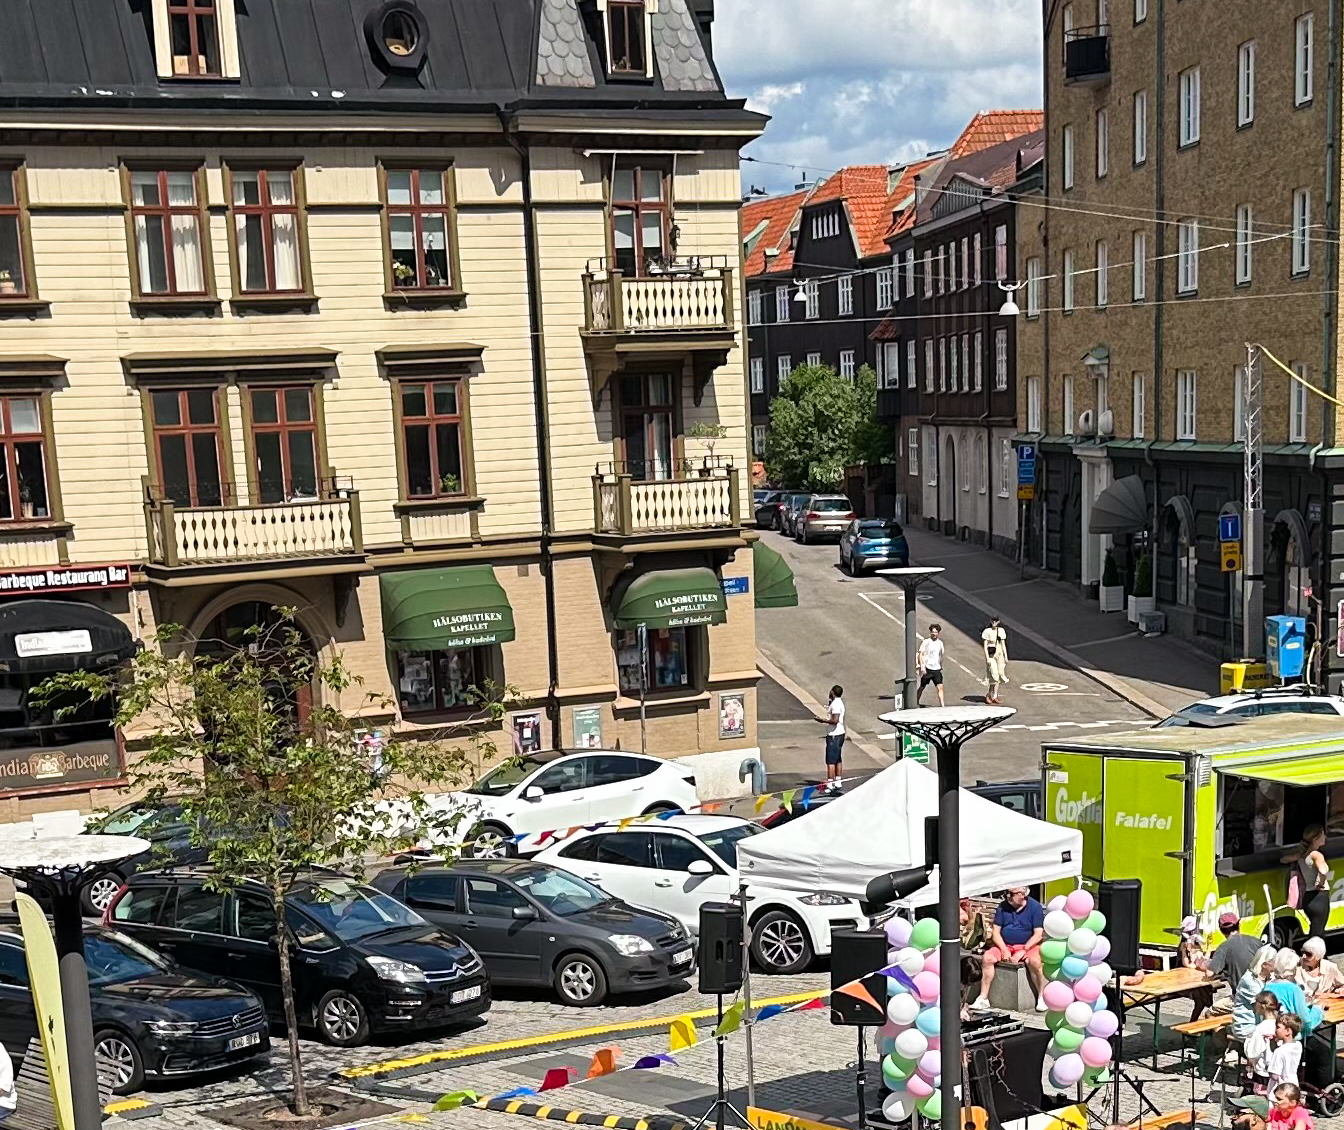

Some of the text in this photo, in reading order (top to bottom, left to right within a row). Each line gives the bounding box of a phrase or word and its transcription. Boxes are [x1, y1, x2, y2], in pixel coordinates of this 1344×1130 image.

[1023, 446, 1032, 460] P
[46, 568, 108, 586] Restaurang
[109, 566, 127, 582] Bar
[655, 594, 718, 608] HÄLSOBUTIKEN
[672, 604, 706, 613] KAPELLET
[432, 612, 502, 628] HÄLSOBUTIKEN
[450, 622, 488, 633] KAPELLET
[1115, 812, 1172, 830] Falafel
